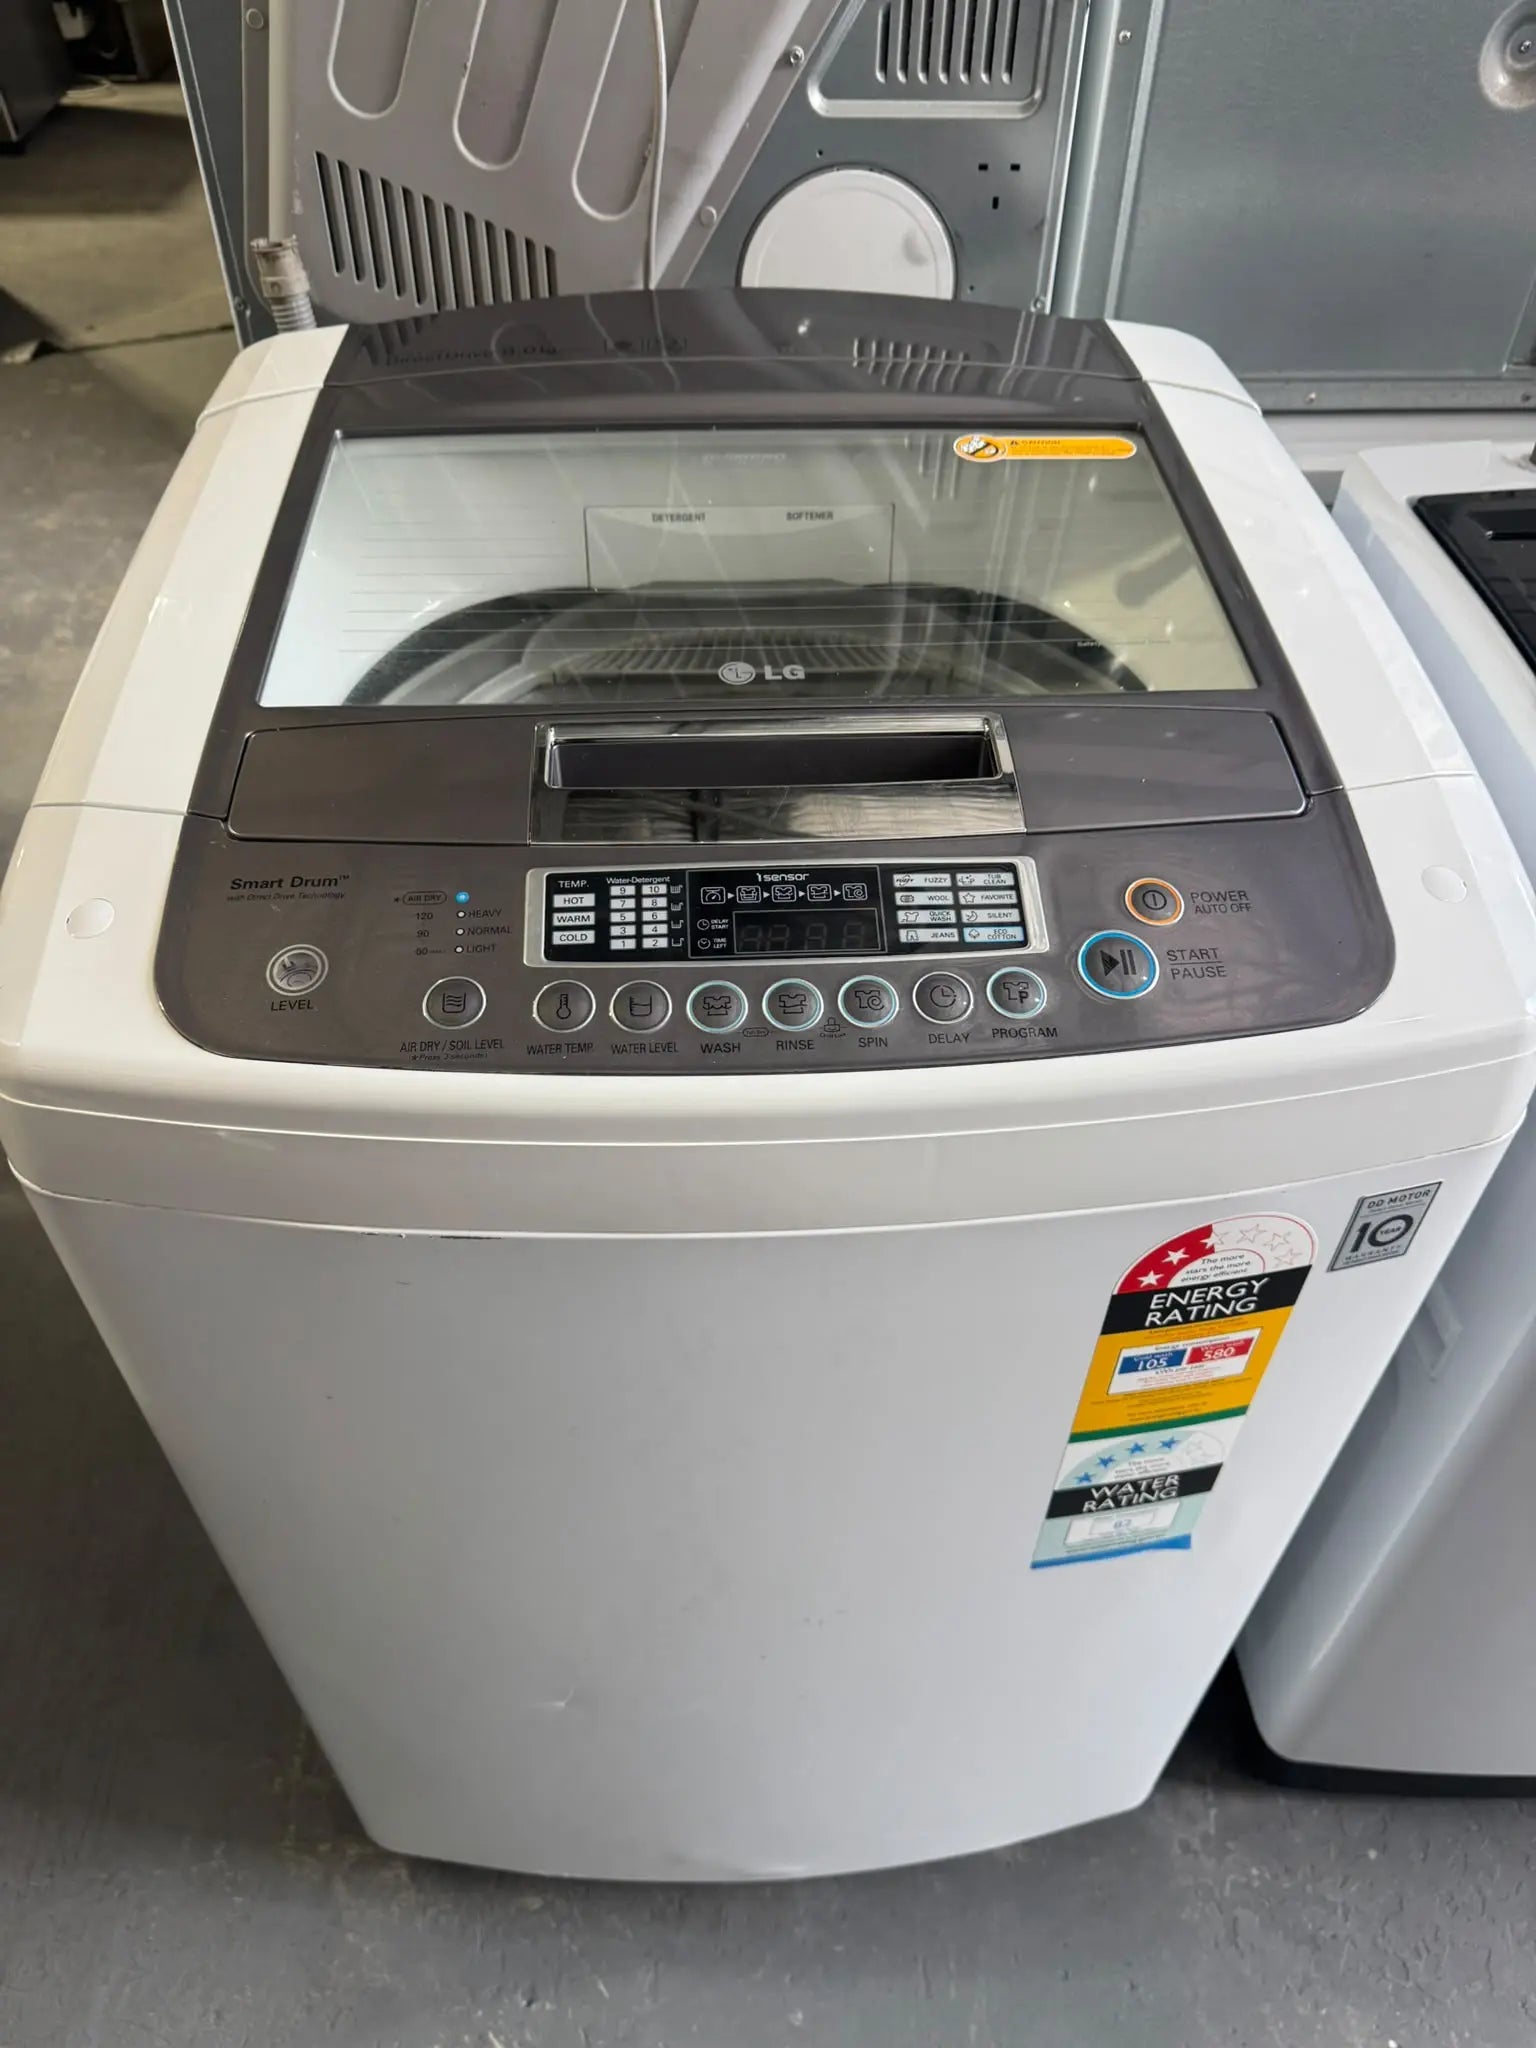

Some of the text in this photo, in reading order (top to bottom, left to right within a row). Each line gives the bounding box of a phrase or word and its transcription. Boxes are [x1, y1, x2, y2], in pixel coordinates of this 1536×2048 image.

[652, 512, 706, 523] DETERGENT
[786, 511, 834, 521] SOFTENER
[764, 664, 806, 680] LG
[230, 877, 284, 890] Smart
[619, 885, 660, 895] 9 10
[408, 893, 442, 901] AIR DRY
[563, 896, 585, 905] HOT
[981, 893, 1014, 901] FAVORITE
[1190, 890, 1249, 904] POWER
[619, 899, 658, 908] 7 8
[1195, 902, 1252, 914] AUTO OFF
[416, 911, 434, 920] 120
[468, 908, 502, 918] HEAVY
[556, 914, 591, 923] WARM
[619, 912, 658, 921] 5 6
[987, 911, 1013, 919] SILENT
[416, 929, 430, 938] 90
[467, 924, 512, 936] NORMAL
[619, 925, 659, 935] 3 4
[930, 930, 956, 939] JEANS
[559, 933, 588, 942] COLD
[466, 943, 496, 953] LIGHT
[620, 939, 658, 949] 1 2
[1166, 948, 1220, 962] START
[1171, 965, 1227, 980] PAUSE
[270, 1000, 314, 1012] LEVEL
[929, 1032, 970, 1044] DELAY
[991, 1027, 1058, 1039] PROGRAM
[400, 1041, 417, 1052] AIR
[420, 1040, 440, 1051] DRY
[449, 1039, 472, 1050] SOIL
[475, 1039, 504, 1050] LEVEL
[611, 1042, 679, 1054] WATER LEVEL
[701, 1042, 741, 1053] WASH
[776, 1039, 815, 1050] RINSE
[858, 1037, 888, 1048] SPIN
[527, 1043, 594, 1055] WATER TEMP
[1387, 1189, 1431, 1205] MOTOR
[1350, 1214, 1414, 1253] 10
[1220, 1254, 1245, 1262] more
[1185, 1260, 1251, 1275] stars the more
[1150, 1277, 1269, 1309] ENERGY
[1145, 1296, 1258, 1327] RATING
[1202, 1346, 1236, 1361] 580
[1138, 1357, 1168, 1370] 105
[1090, 1474, 1180, 1500] WATER
[1083, 1487, 1177, 1513] RATING
